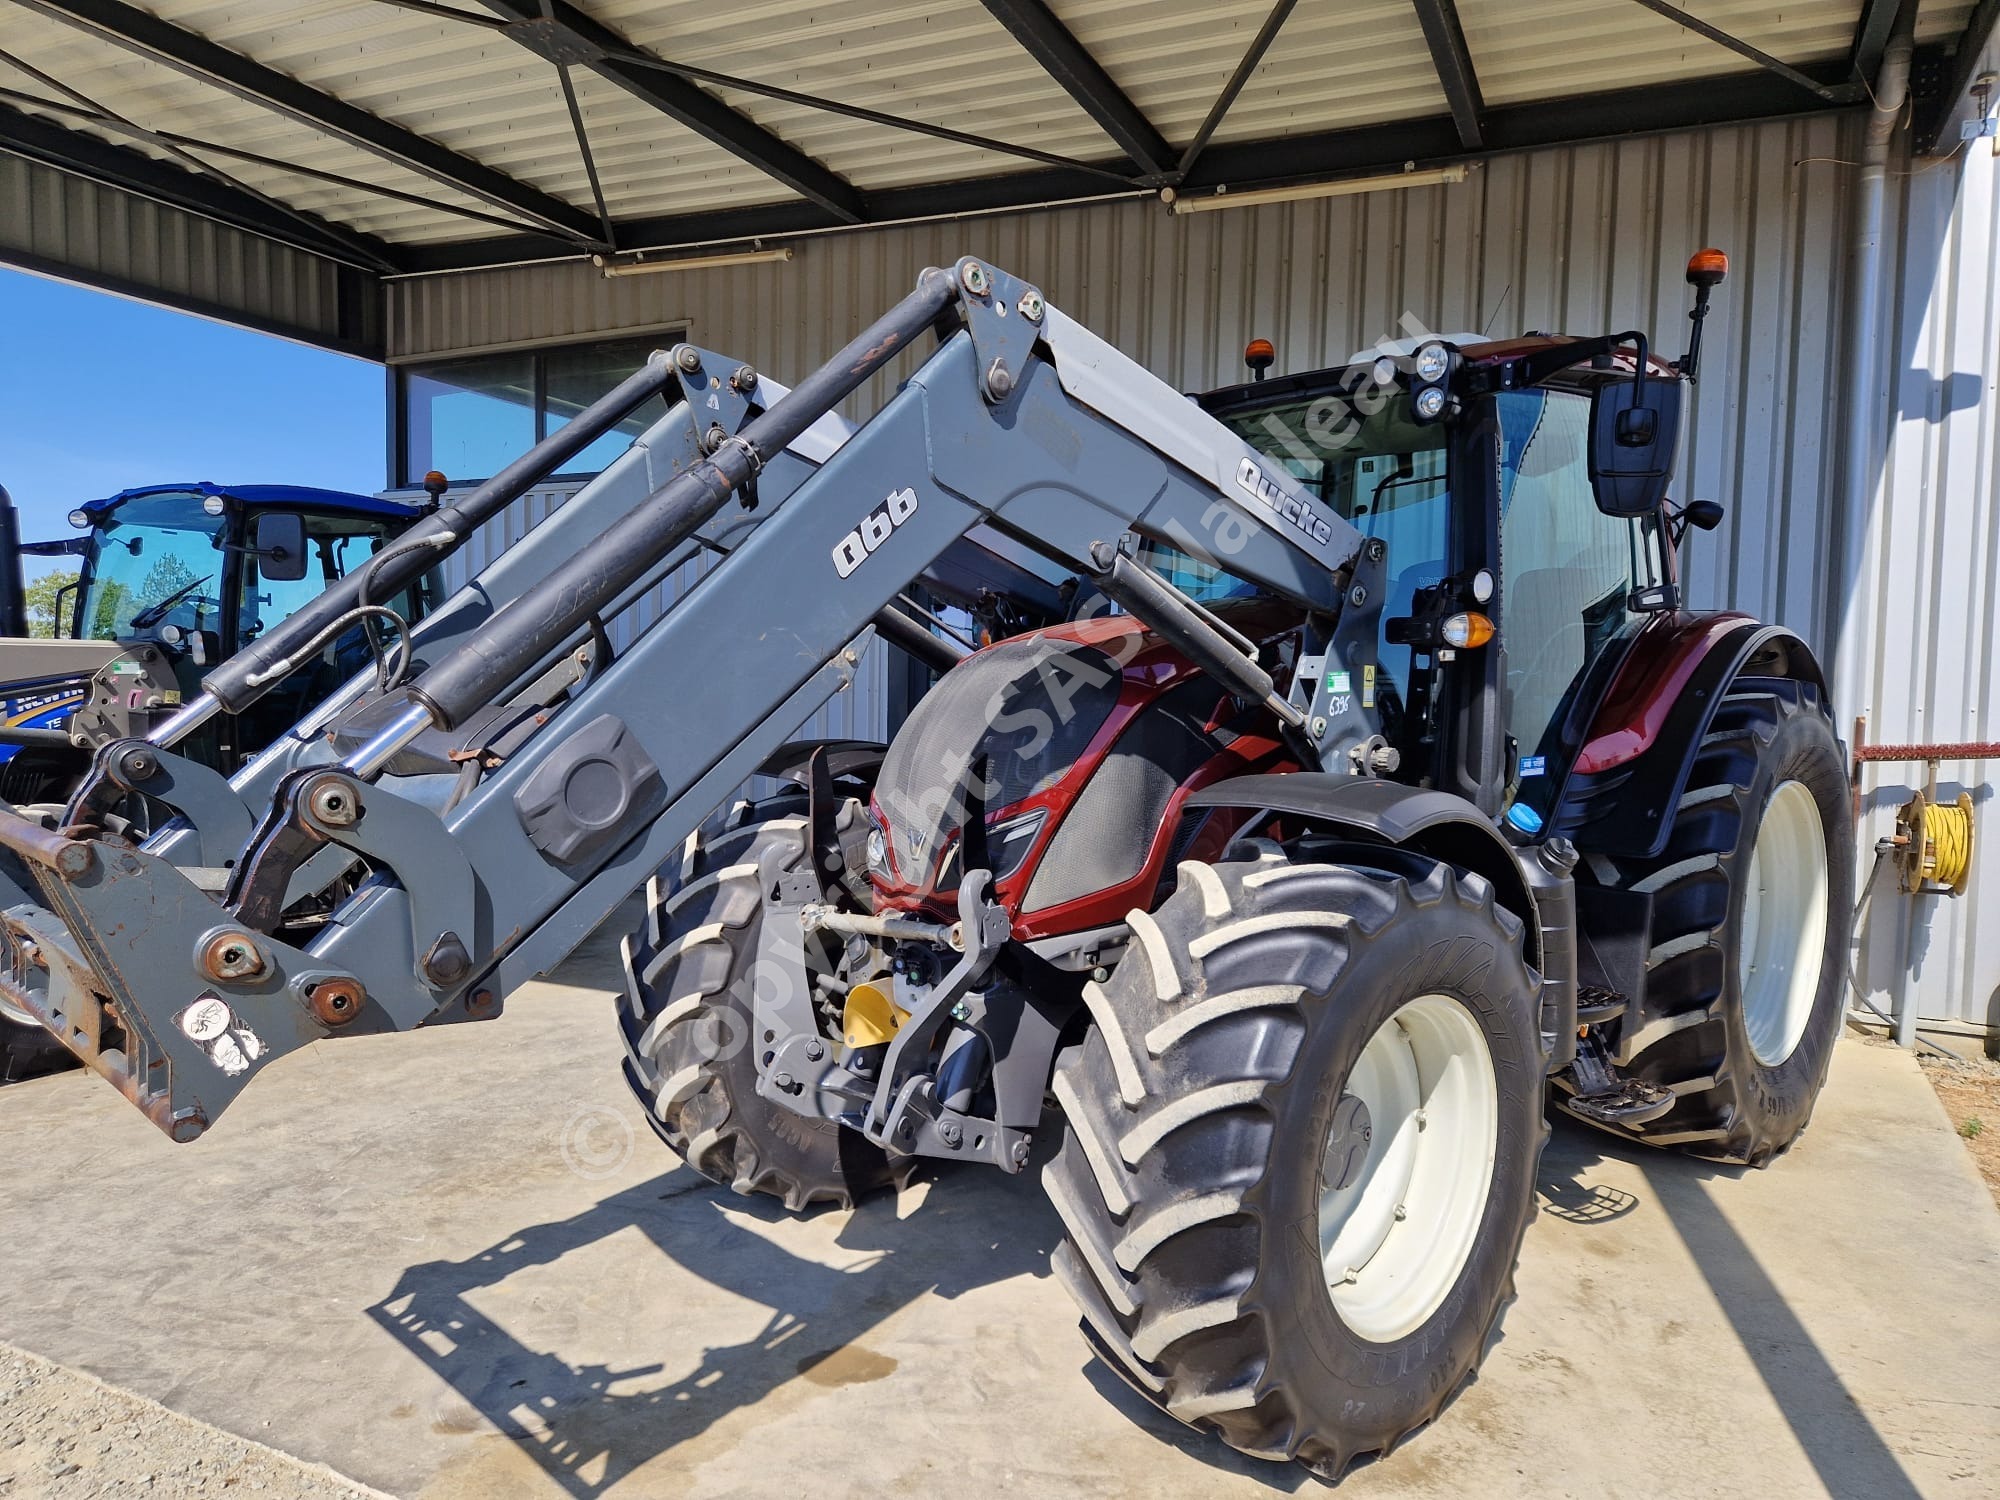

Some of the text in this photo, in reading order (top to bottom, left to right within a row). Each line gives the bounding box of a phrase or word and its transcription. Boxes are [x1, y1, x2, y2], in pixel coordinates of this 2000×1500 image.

[832, 487, 918, 579] Q66
[1236, 457, 1332, 546] Quicke
[1329, 695, 1350, 717] 6396
